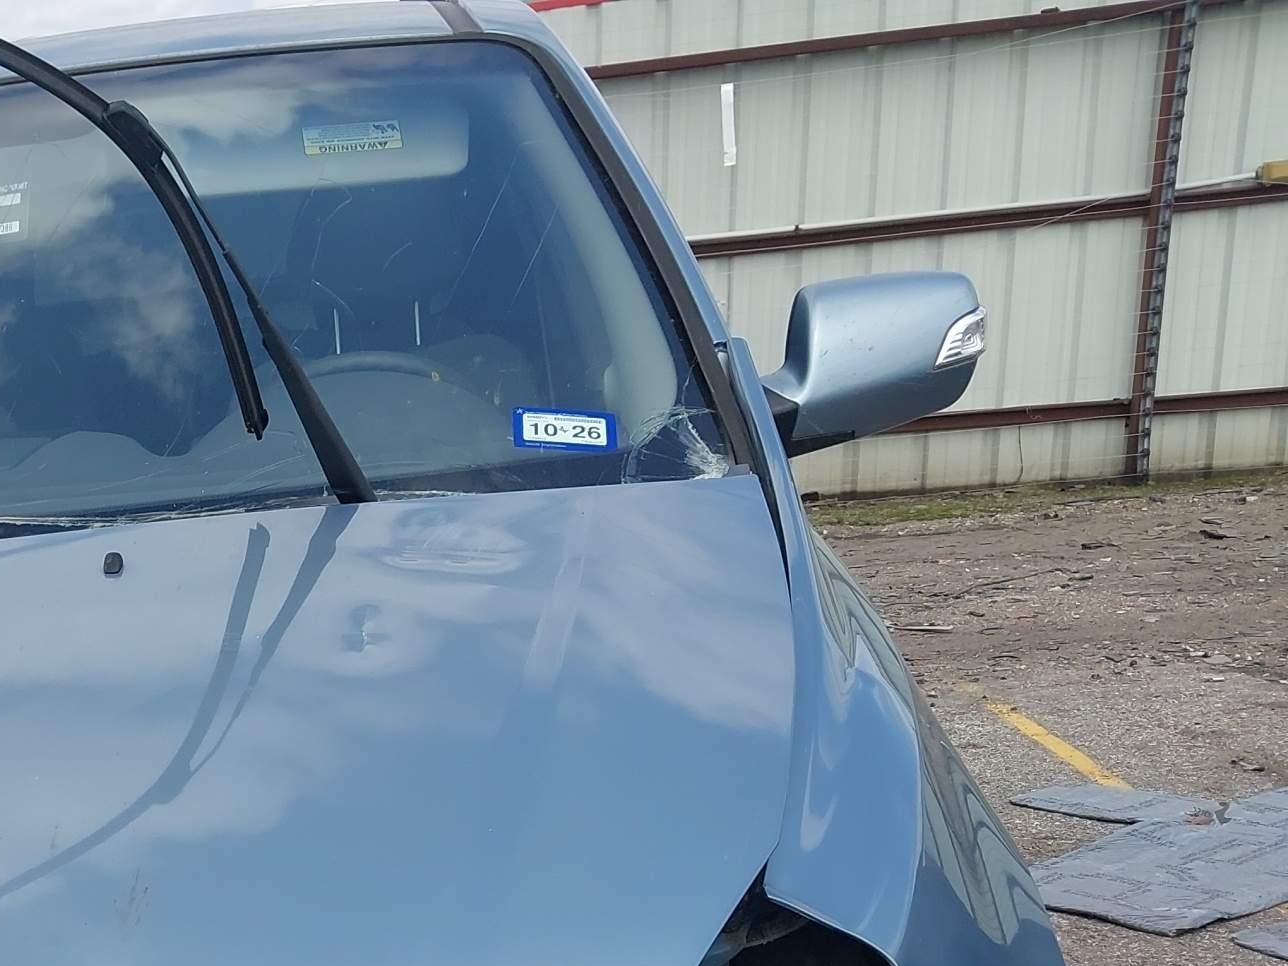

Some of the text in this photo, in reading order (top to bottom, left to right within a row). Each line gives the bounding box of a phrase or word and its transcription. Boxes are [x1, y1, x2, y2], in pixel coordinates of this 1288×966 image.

[319, 142, 379, 153] WARNING
[529, 422, 601, 440] 10 26
